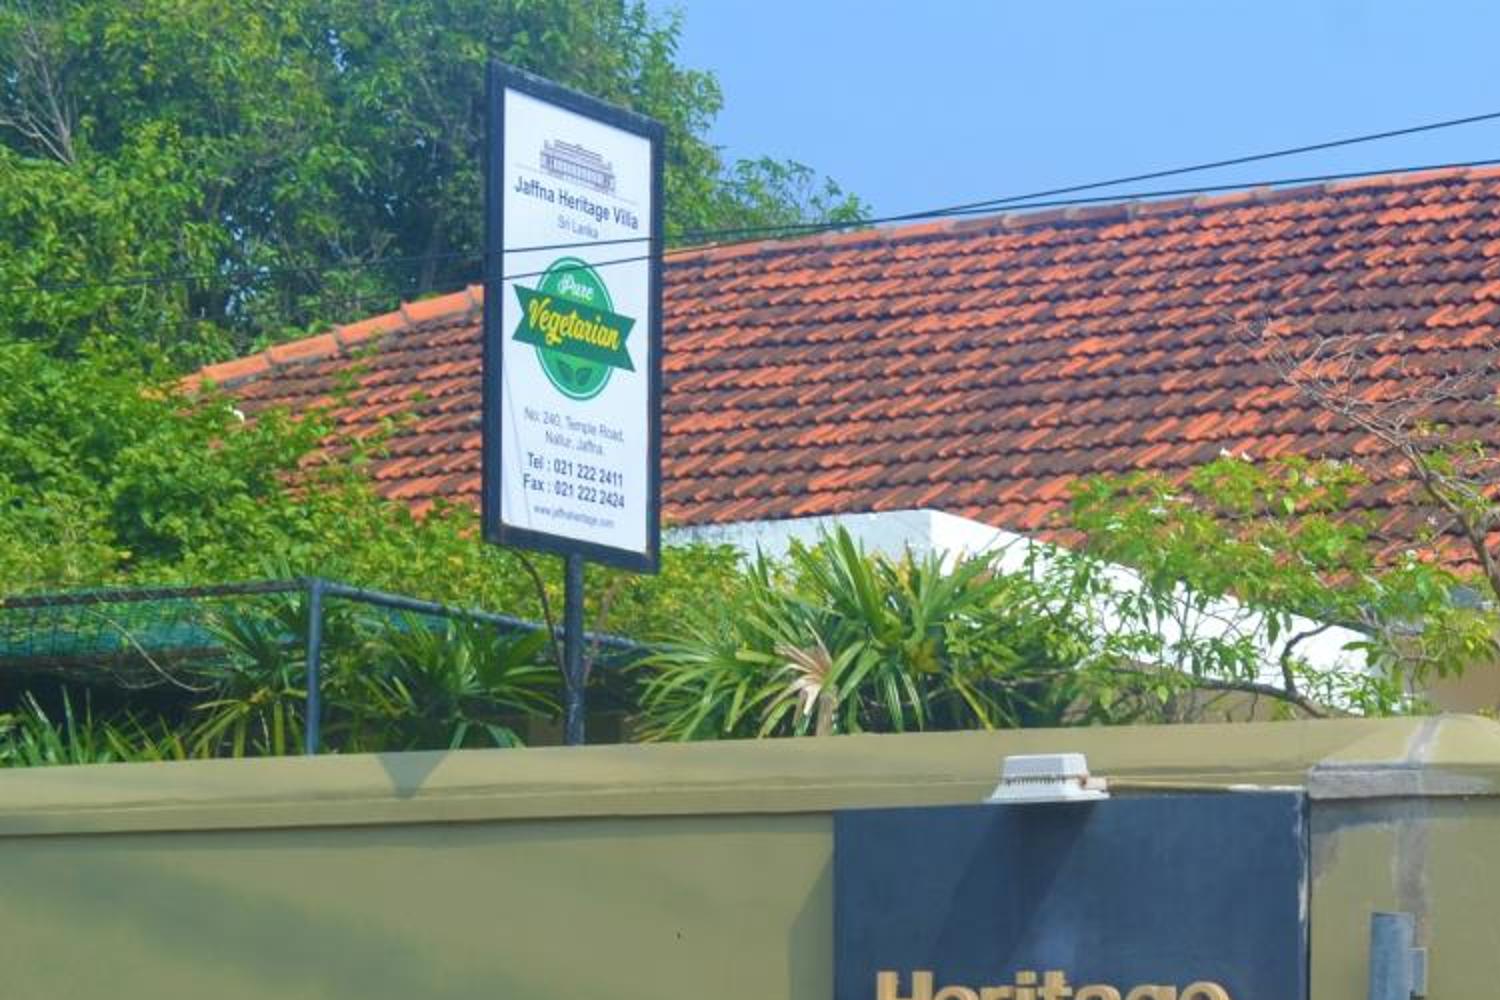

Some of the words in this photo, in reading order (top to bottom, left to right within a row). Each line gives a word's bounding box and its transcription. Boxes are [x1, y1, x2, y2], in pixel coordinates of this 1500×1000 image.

[515, 175, 555, 203] Jaffna
[559, 188, 610, 222] Heritage
[613, 206, 639, 230] Villa
[557, 214, 570, 229] Sri
[572, 219, 599, 239] Lanka
[528, 297, 621, 351] Vegetarian
[565, 416, 596, 435] Temple
[528, 452, 544, 469] Tel
[553, 459, 573, 477] 021
[577, 464, 597, 482] 222
[599, 468, 623, 488] 2411
[523, 473, 544, 492] Fax
[553, 480, 573, 497] 021
[577, 484, 597, 503] 222
[599, 490, 625, 509] 2424
